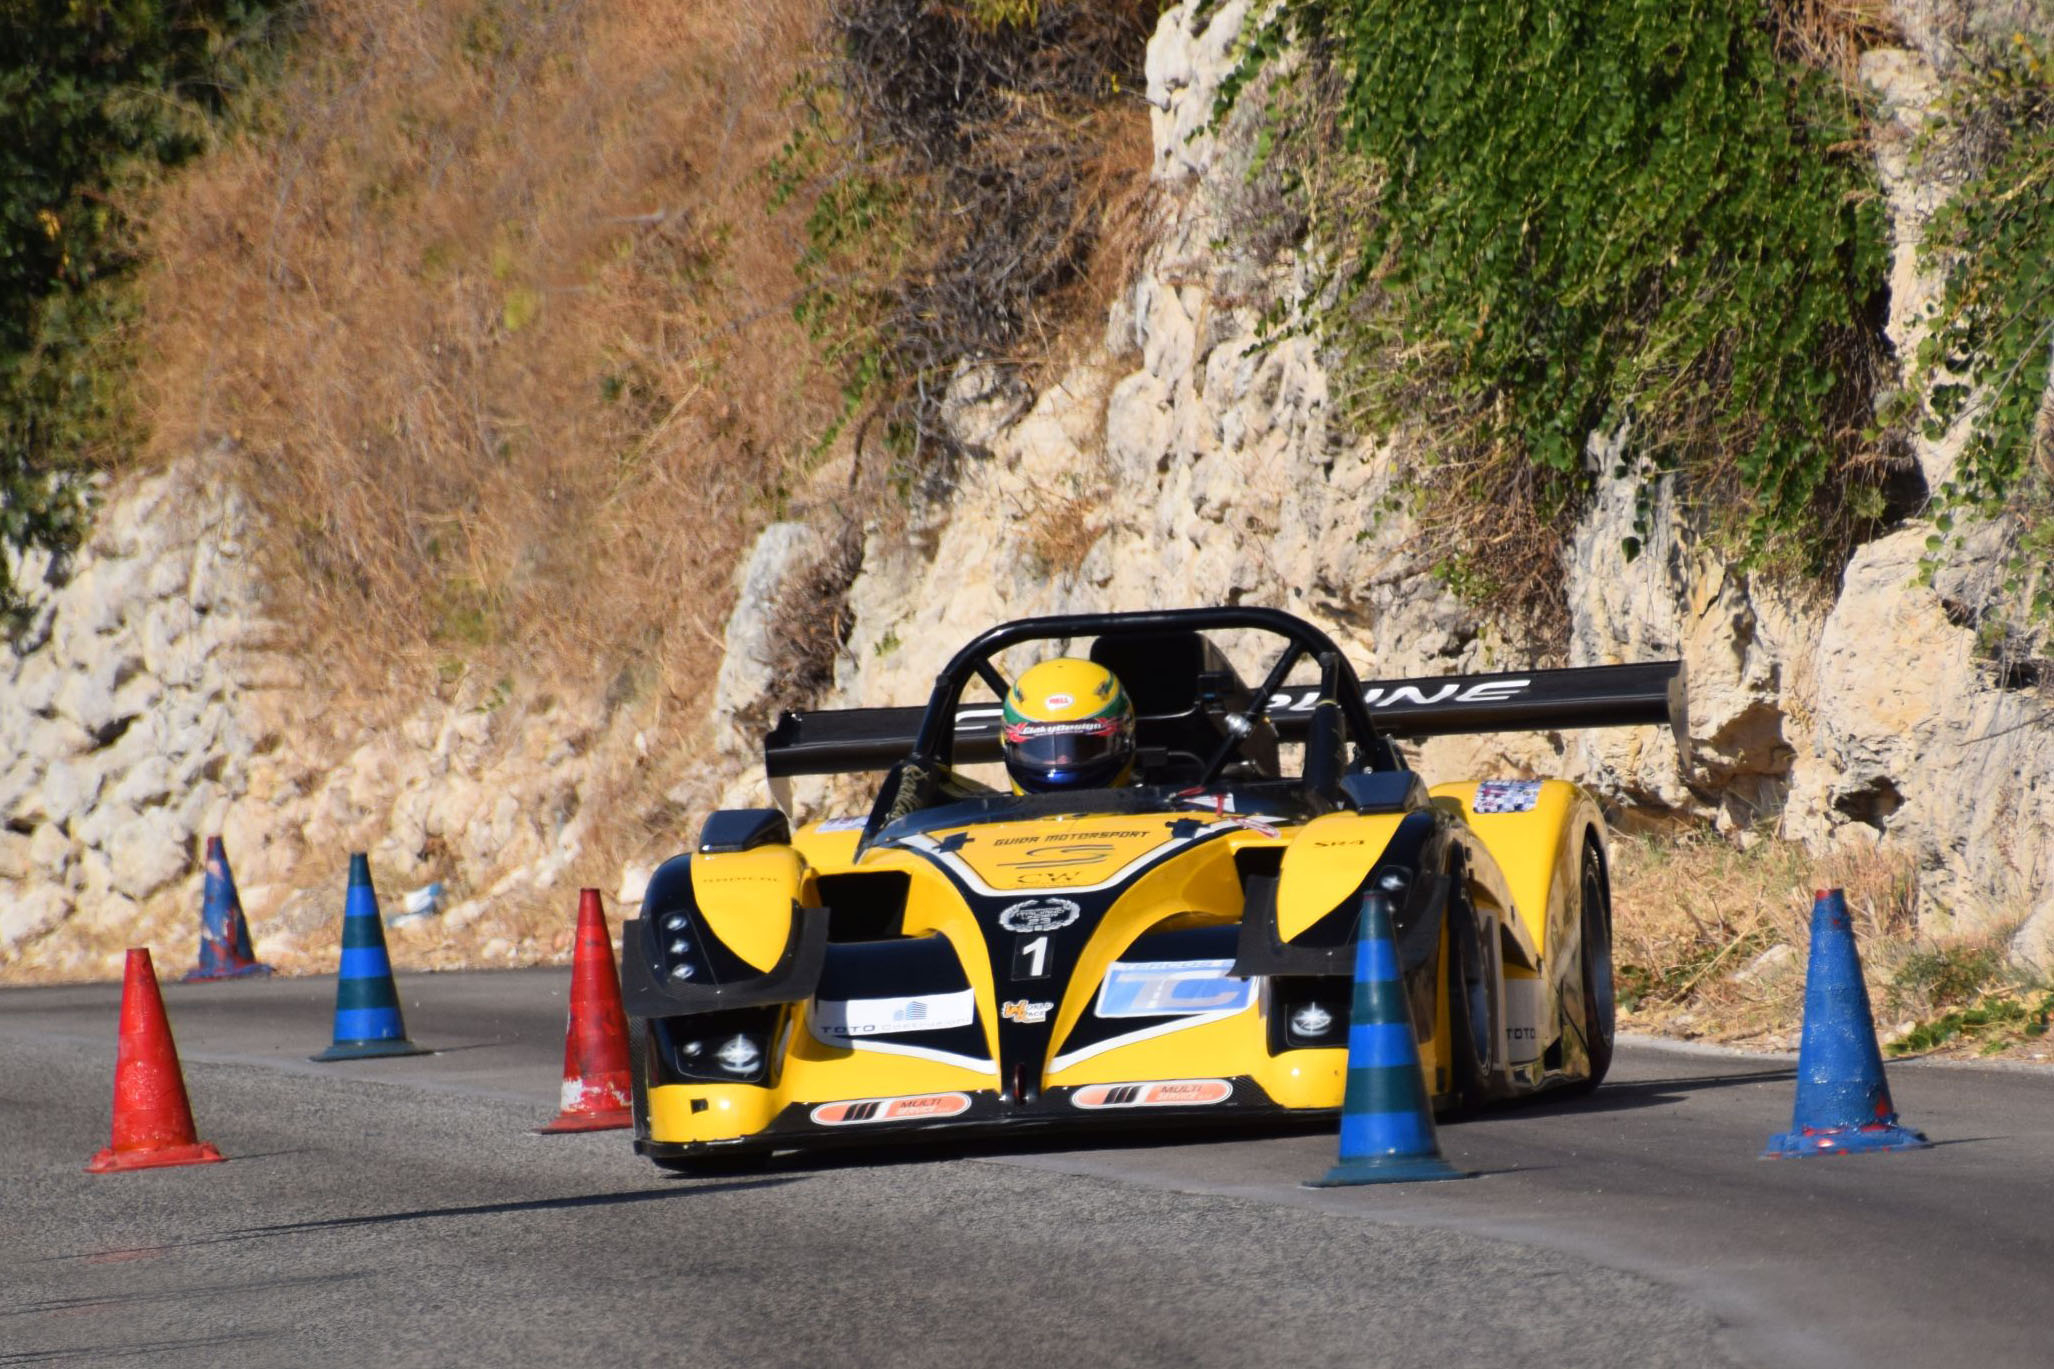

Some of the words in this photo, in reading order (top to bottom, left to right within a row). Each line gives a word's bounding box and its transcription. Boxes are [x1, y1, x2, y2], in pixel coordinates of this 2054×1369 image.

[1045, 830, 1150, 842] MOTORSPORT
[1022, 936, 1048, 977] 1
[820, 1024, 876, 1034] TOTO
[1506, 1028, 1535, 1039] TOTO
[1160, 1083, 1202, 1094] MULTI
[901, 1098, 942, 1109] MULTI
